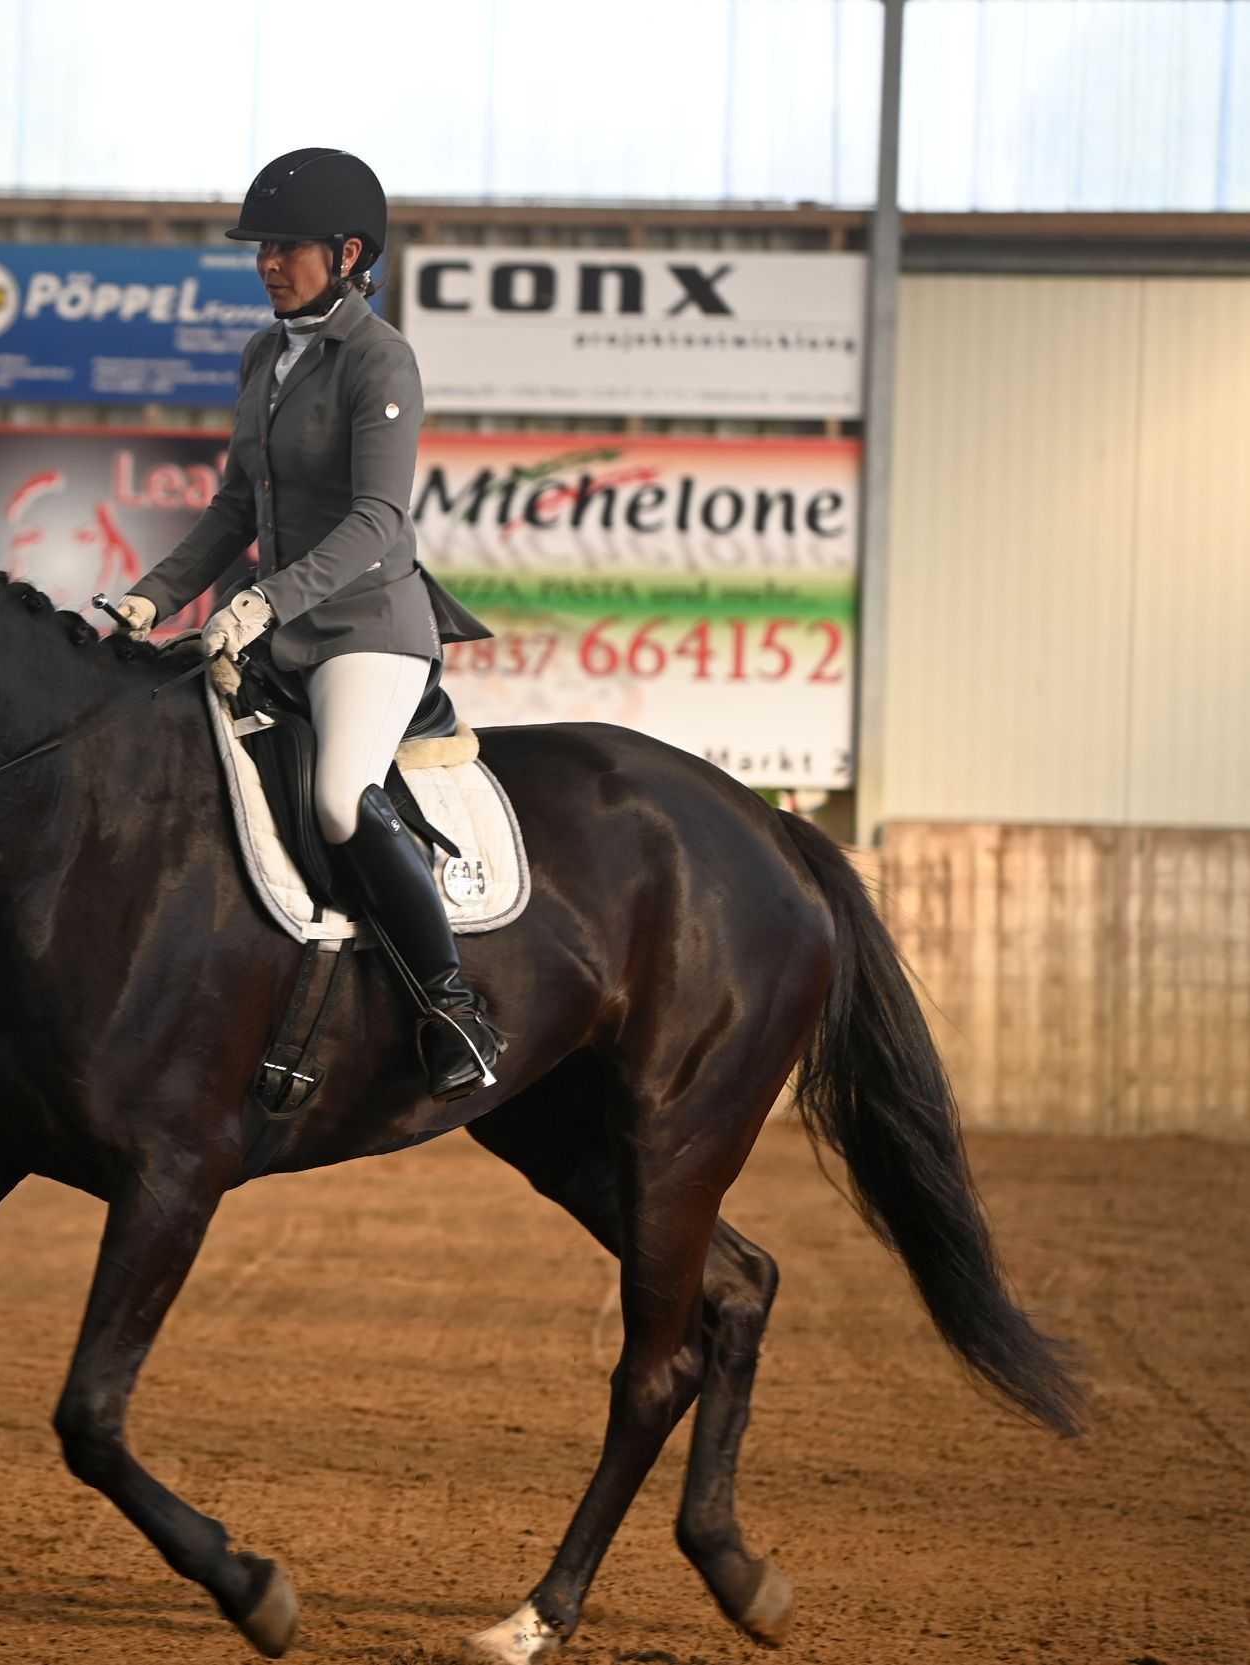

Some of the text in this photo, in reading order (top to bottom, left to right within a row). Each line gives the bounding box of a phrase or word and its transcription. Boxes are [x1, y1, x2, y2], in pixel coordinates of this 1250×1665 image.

[24, 272, 199, 322] PÖPPEL
[417, 260, 736, 317] conx
[113, 450, 230, 510] Lea
[412, 463, 848, 537] Michelone
[579, 616, 847, 685] 664152
